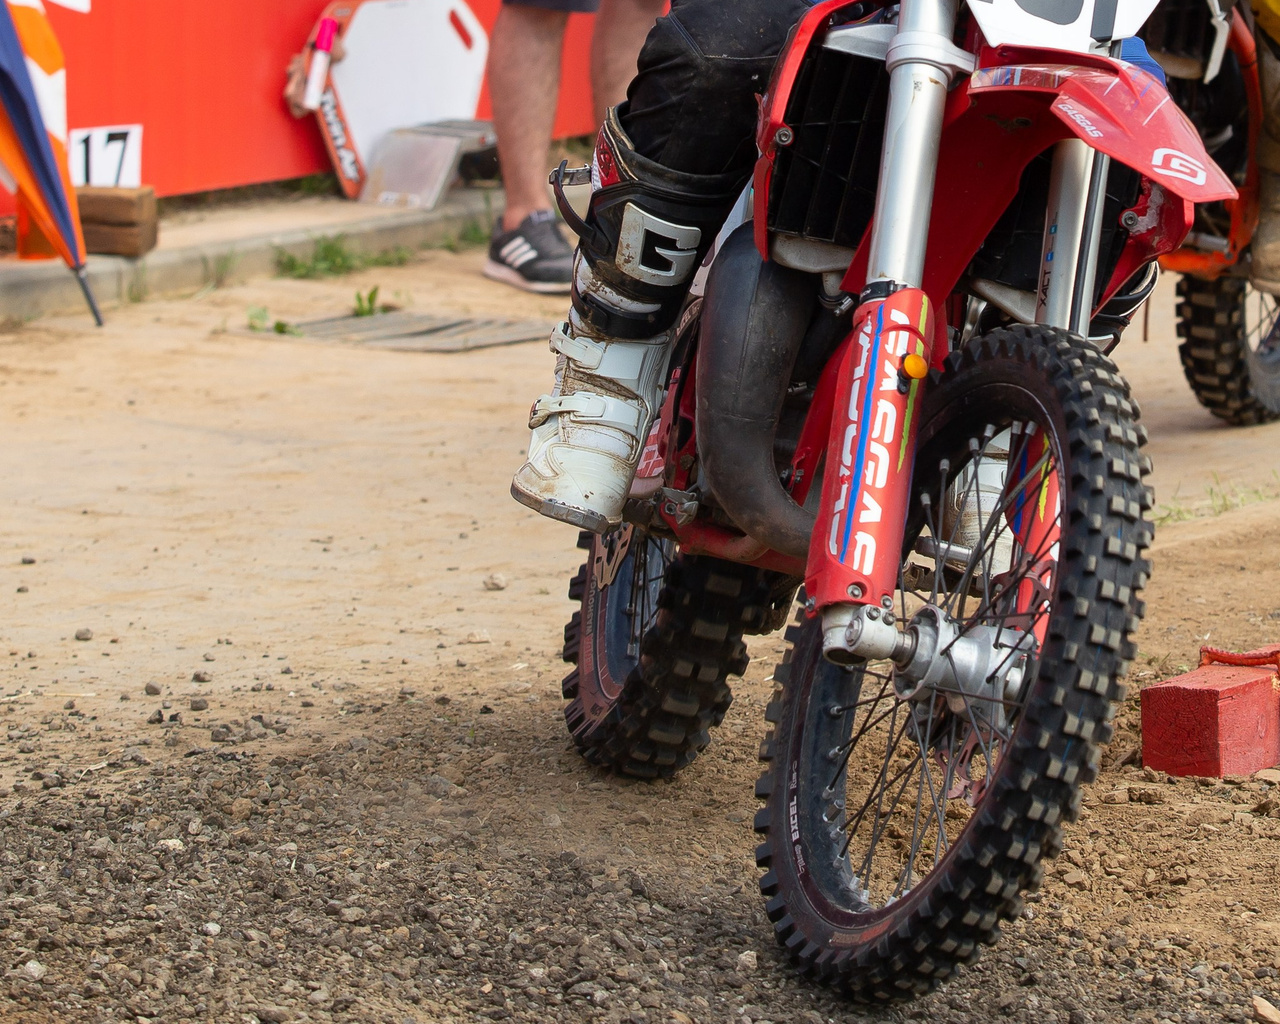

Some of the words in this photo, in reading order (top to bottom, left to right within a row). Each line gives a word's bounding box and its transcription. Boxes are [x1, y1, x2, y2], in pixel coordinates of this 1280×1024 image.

[1057, 103, 1103, 139] GASGAS
[79, 131, 130, 185] 17
[1039, 269, 1052, 307] XACT
[585, 575, 597, 636] WASHOUGA
[789, 795, 800, 843] EXCEL
